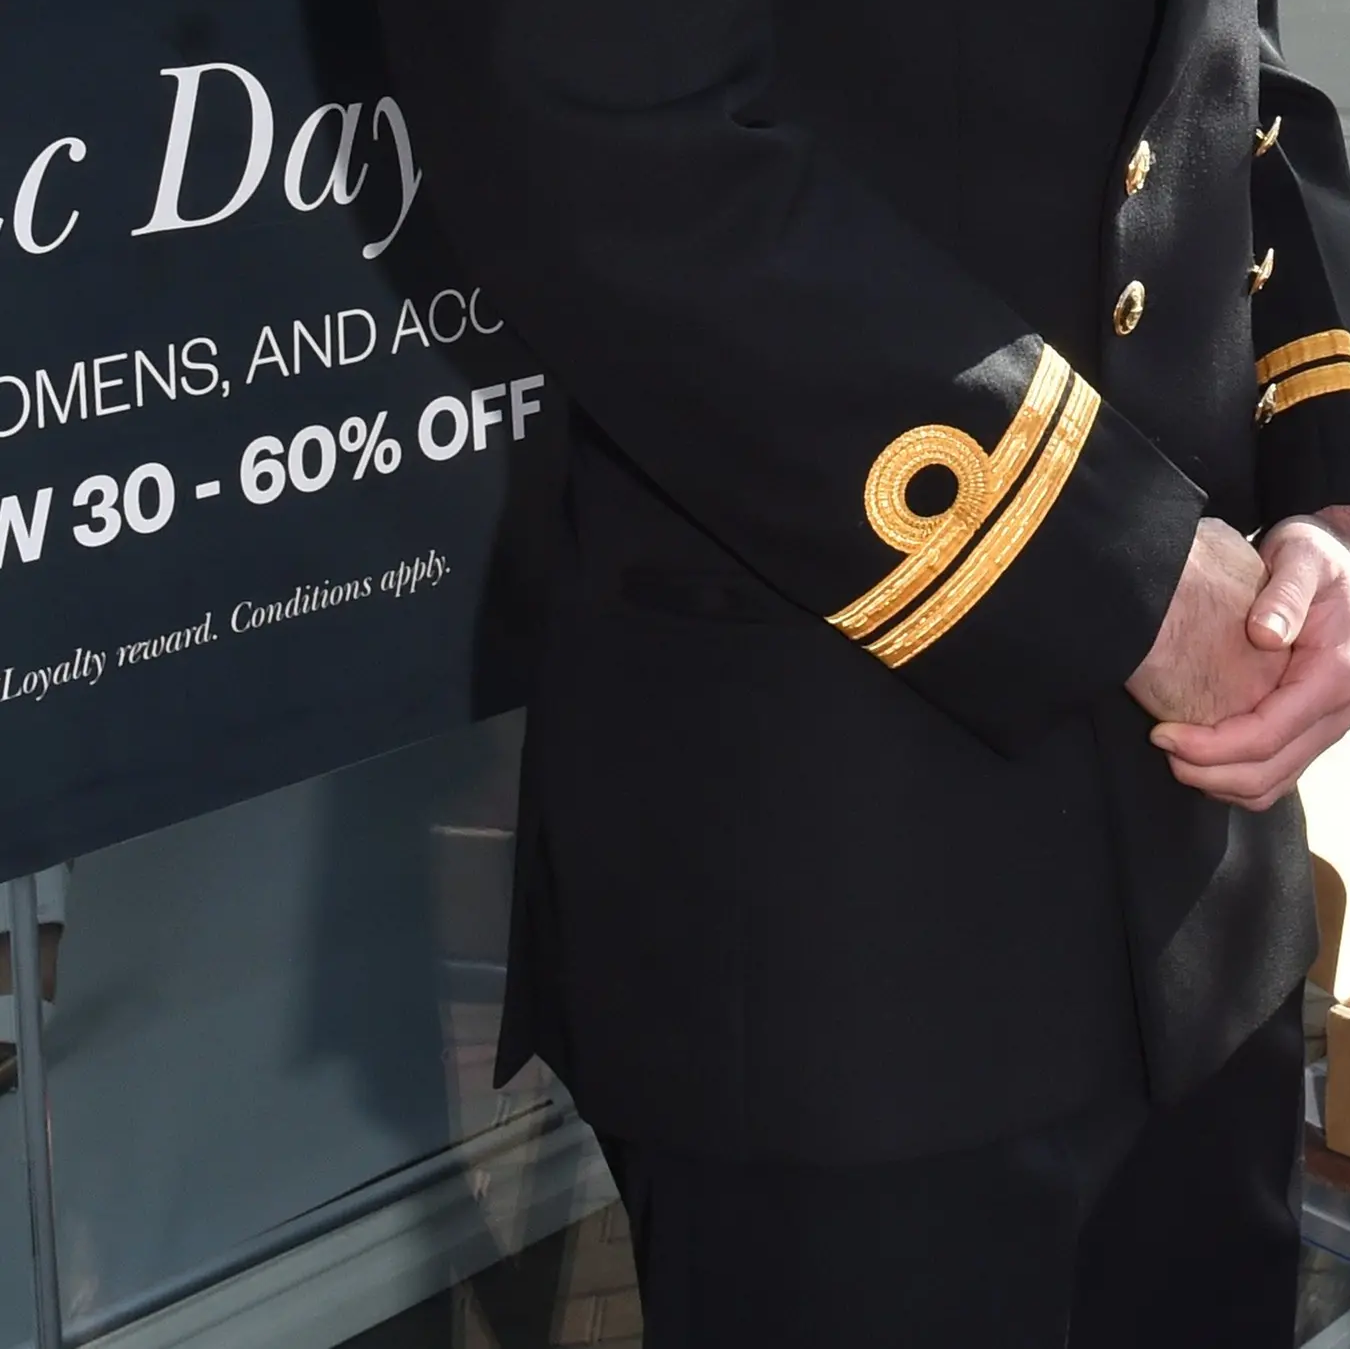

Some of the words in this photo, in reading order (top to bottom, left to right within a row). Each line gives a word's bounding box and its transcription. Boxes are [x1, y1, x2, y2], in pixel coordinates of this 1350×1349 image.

[130, 62, 422, 260] Day
[246, 308, 377, 385] AND
[72, 462, 176, 548] 30
[195, 479, 221, 500] -
[239, 410, 402, 505] 60%
[417, 374, 545, 462] OFF
[0, 647, 107, 702] Loyalty
[117, 611, 218, 668] reward.
[230, 579, 373, 634] Conditions
[380, 549, 451, 599] apply.
